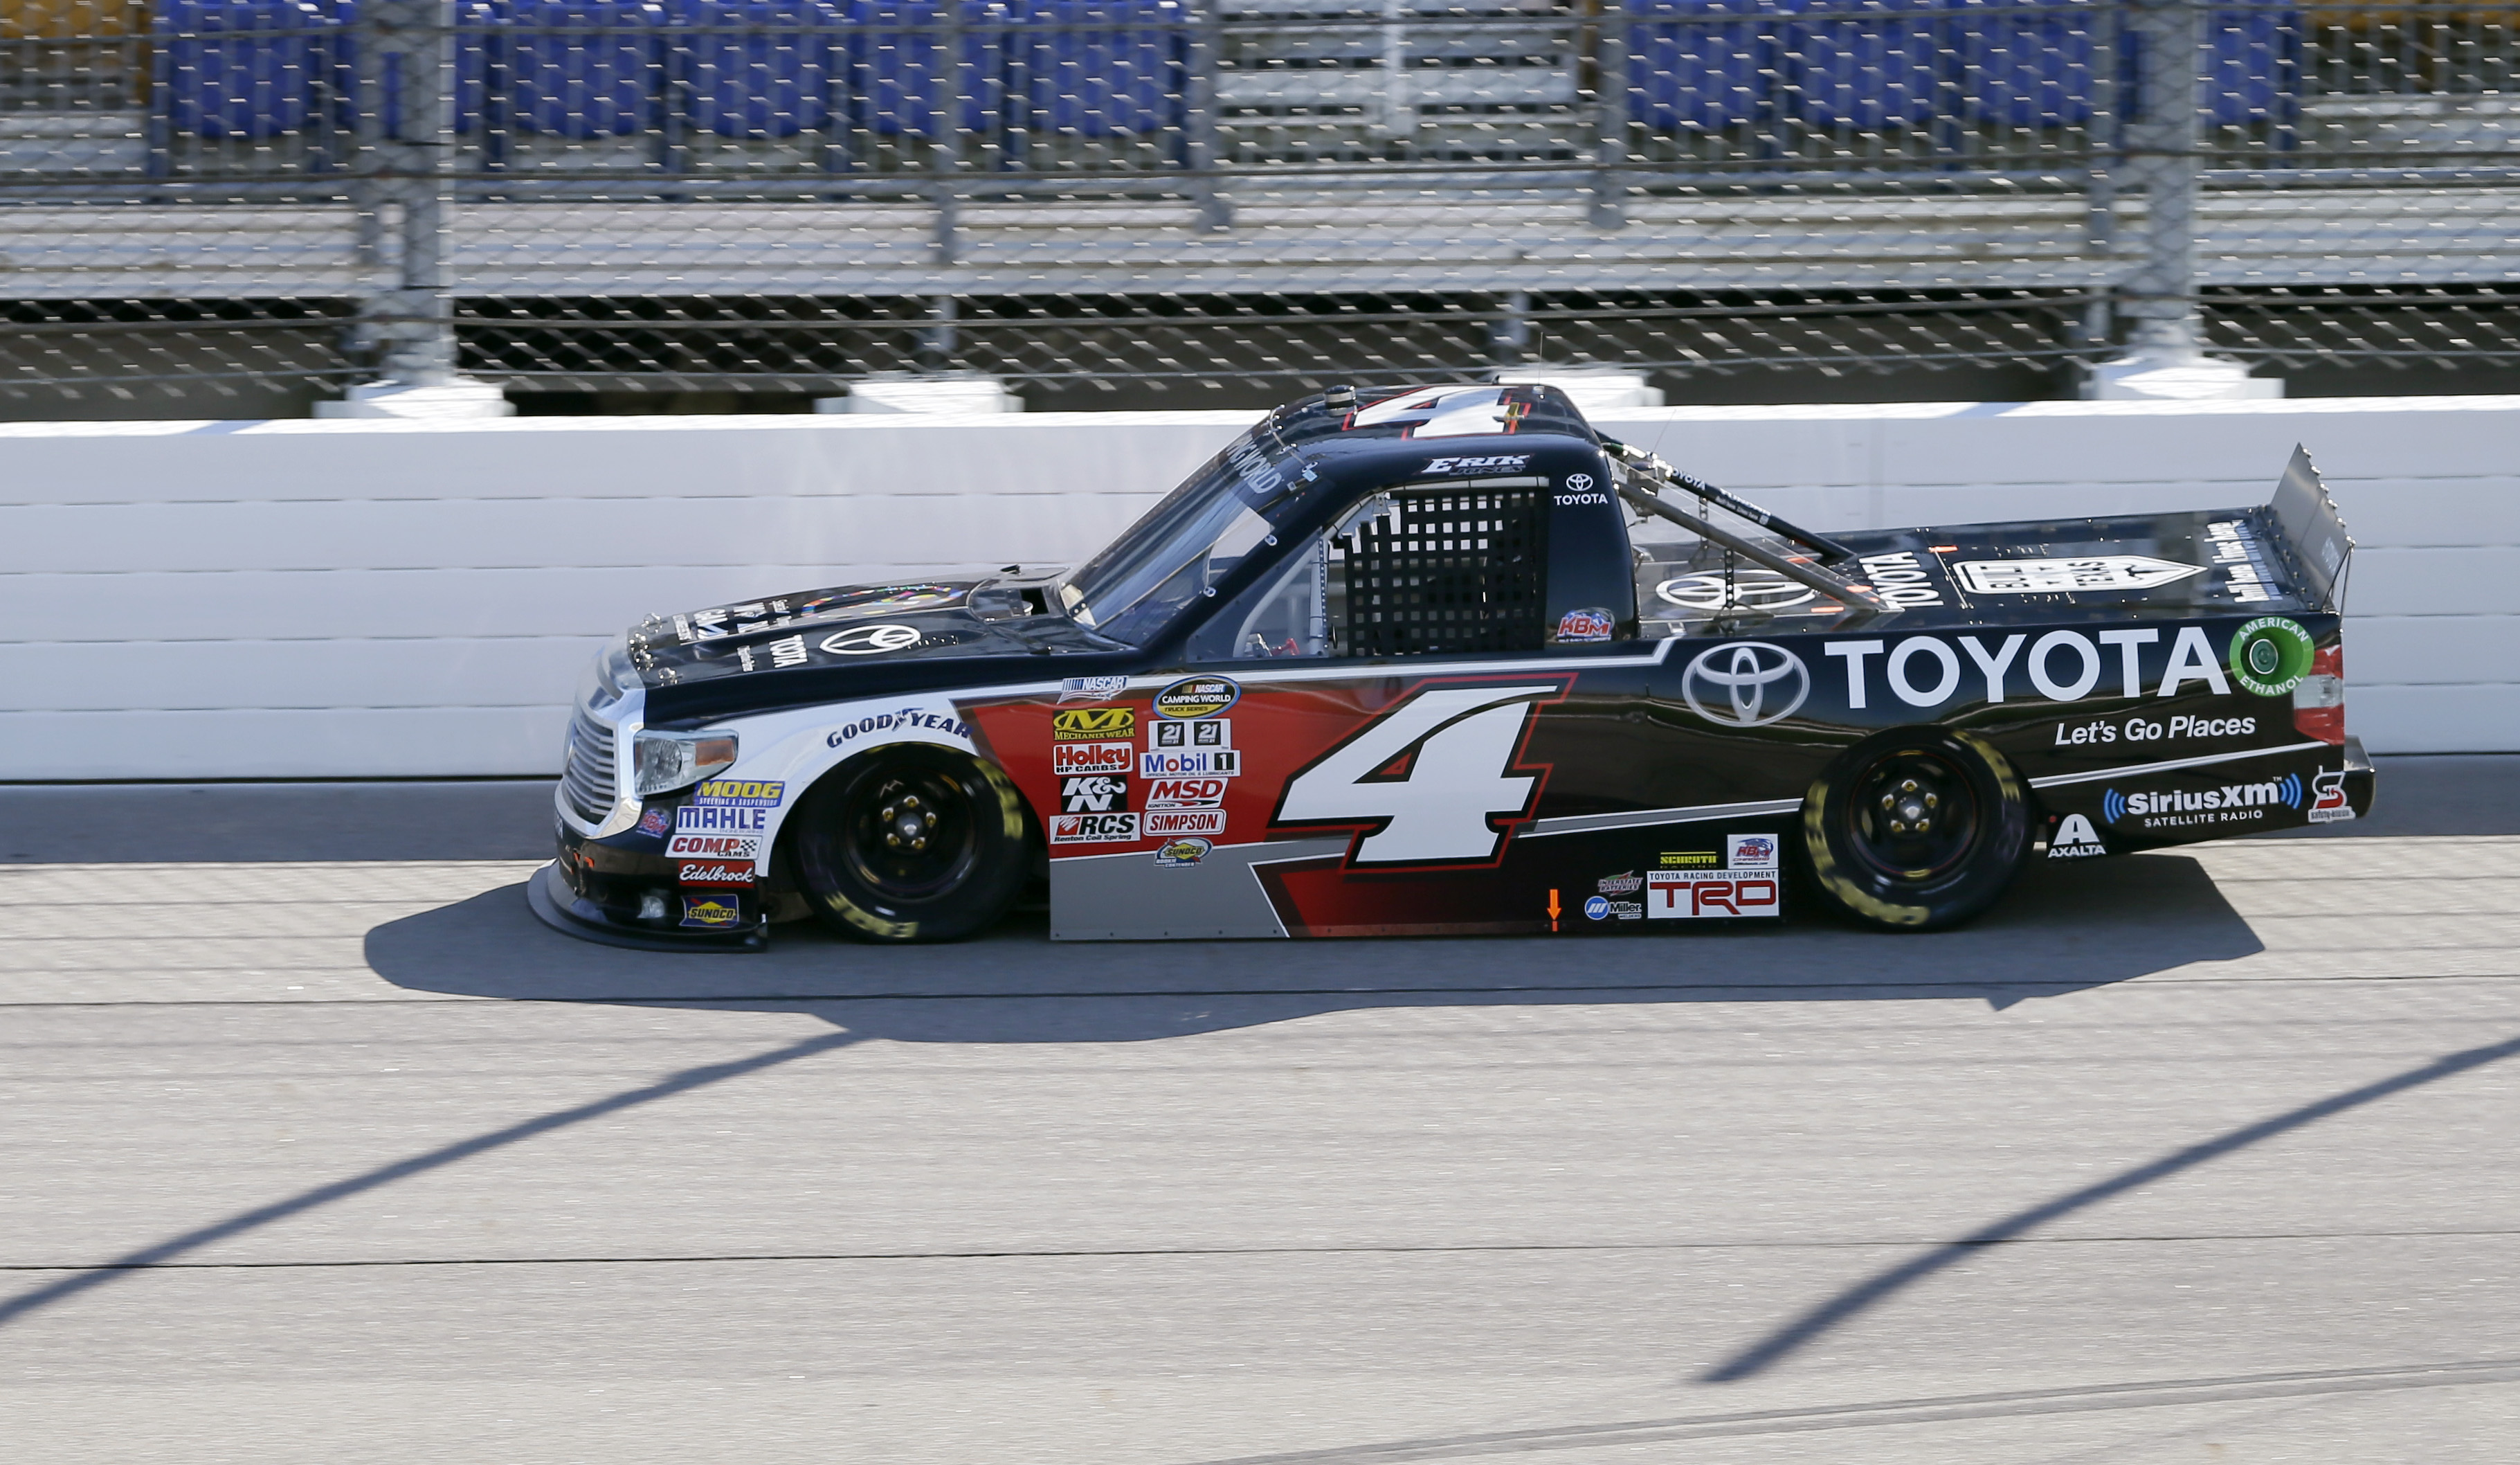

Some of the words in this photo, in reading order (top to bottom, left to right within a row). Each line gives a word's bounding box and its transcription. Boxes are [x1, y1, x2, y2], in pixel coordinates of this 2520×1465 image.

[1353, 386, 1519, 438] 4
[1421, 454, 1530, 473] ERIK
[1667, 464, 1706, 491] OYOTA
[1553, 493, 1608, 506] TOYOTA
[1859, 551, 1944, 610] TOYOTA
[1557, 615, 1612, 637] KBM
[2238, 617, 2310, 643] AMERICAN
[1824, 626, 2232, 710] TOYOTA
[1082, 676, 1125, 690] NASCAR
[1195, 683, 1225, 693] NASCAR
[2239, 674, 2304, 696] ETHANOL
[1161, 695, 1199, 704] CAMPING
[1200, 694, 1231, 703] WORLD
[826, 708, 975, 748] GOODYEAR
[1054, 730, 1105, 741] MECHANIX
[1105, 728, 1135, 738] WEAR
[1161, 724, 1182, 740] 21
[1197, 723, 1219, 739] 21
[2054, 720, 2117, 746] Let's
[2124, 718, 2163, 742] Go
[2167, 714, 2256, 739] Places
[1055, 745, 1130, 770] Holley
[1145, 753, 1207, 773] Mobil
[1277, 685, 1558, 862] 4
[696, 781, 783, 798] MOOG
[1062, 776, 1127, 796] K&
[1152, 780, 1224, 800] MSD
[1067, 794, 1113, 812] N
[678, 807, 766, 829] MAHLE
[1078, 814, 1136, 836] RCS
[1150, 814, 1218, 831] SIMPSON
[2144, 814, 2215, 827] SATELLITE
[2220, 809, 2264, 822] RADIO
[672, 837, 740, 852] COMP
[1166, 847, 1203, 856] SUNOCO
[2047, 844, 2107, 858] AXALTA
[1660, 855, 1717, 864] SCHROTH
[679, 863, 754, 883] Edelbrock
[1716, 870, 1777, 879] DEVELOPMENT
[1609, 902, 1641, 913] Miller
[1649, 880, 1777, 916] TRD
[690, 908, 735, 919] SUNOCO
